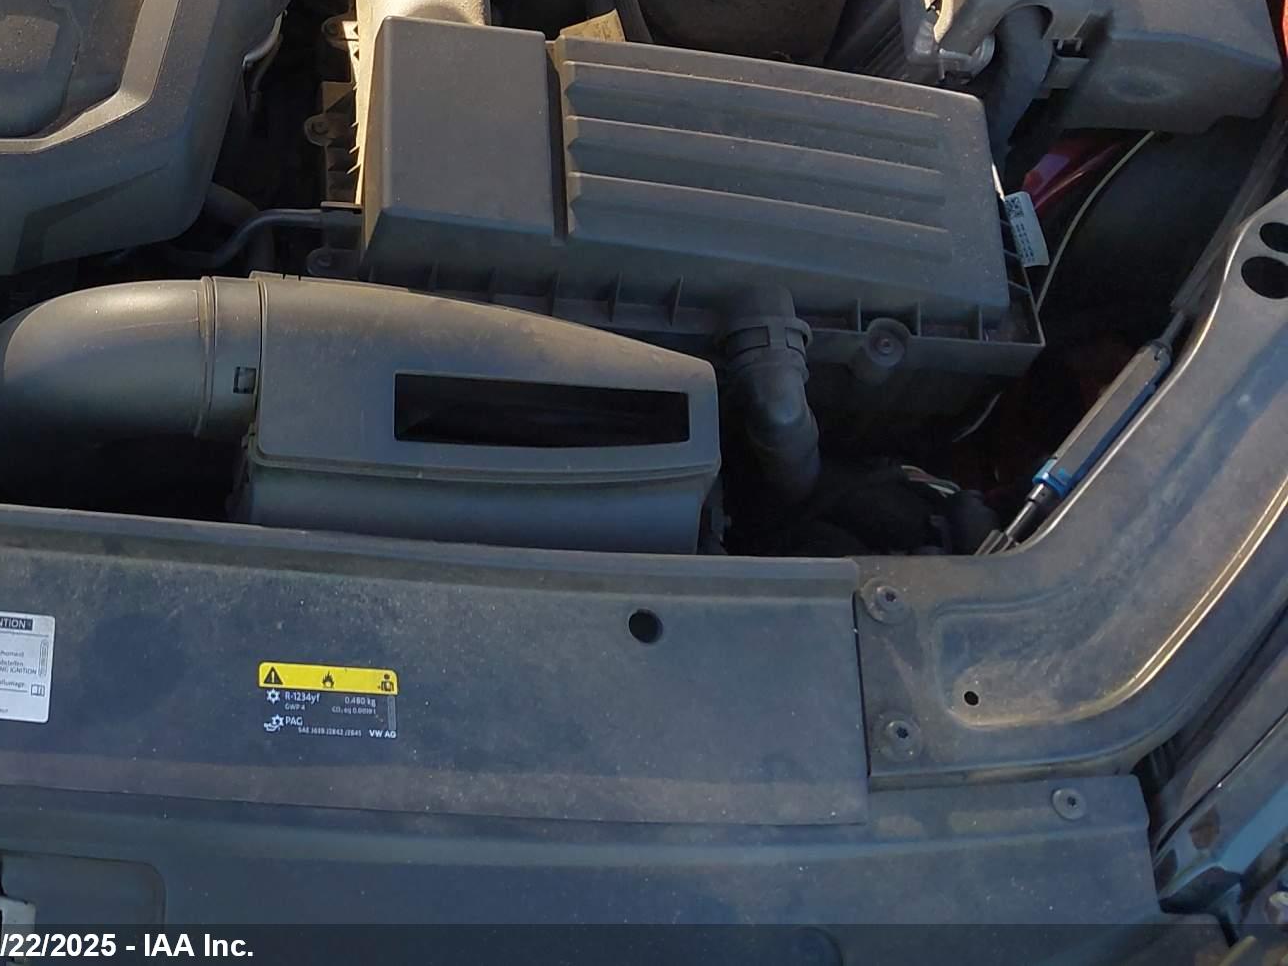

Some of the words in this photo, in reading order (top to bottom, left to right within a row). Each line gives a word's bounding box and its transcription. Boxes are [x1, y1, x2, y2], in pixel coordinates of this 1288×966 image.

[285, 691, 320, 704] R-1234yf
[367, 698, 376, 707] kg
[285, 716, 303, 726] PAG
[369, 729, 383, 737] VW
[384, 730, 397, 738] AG
